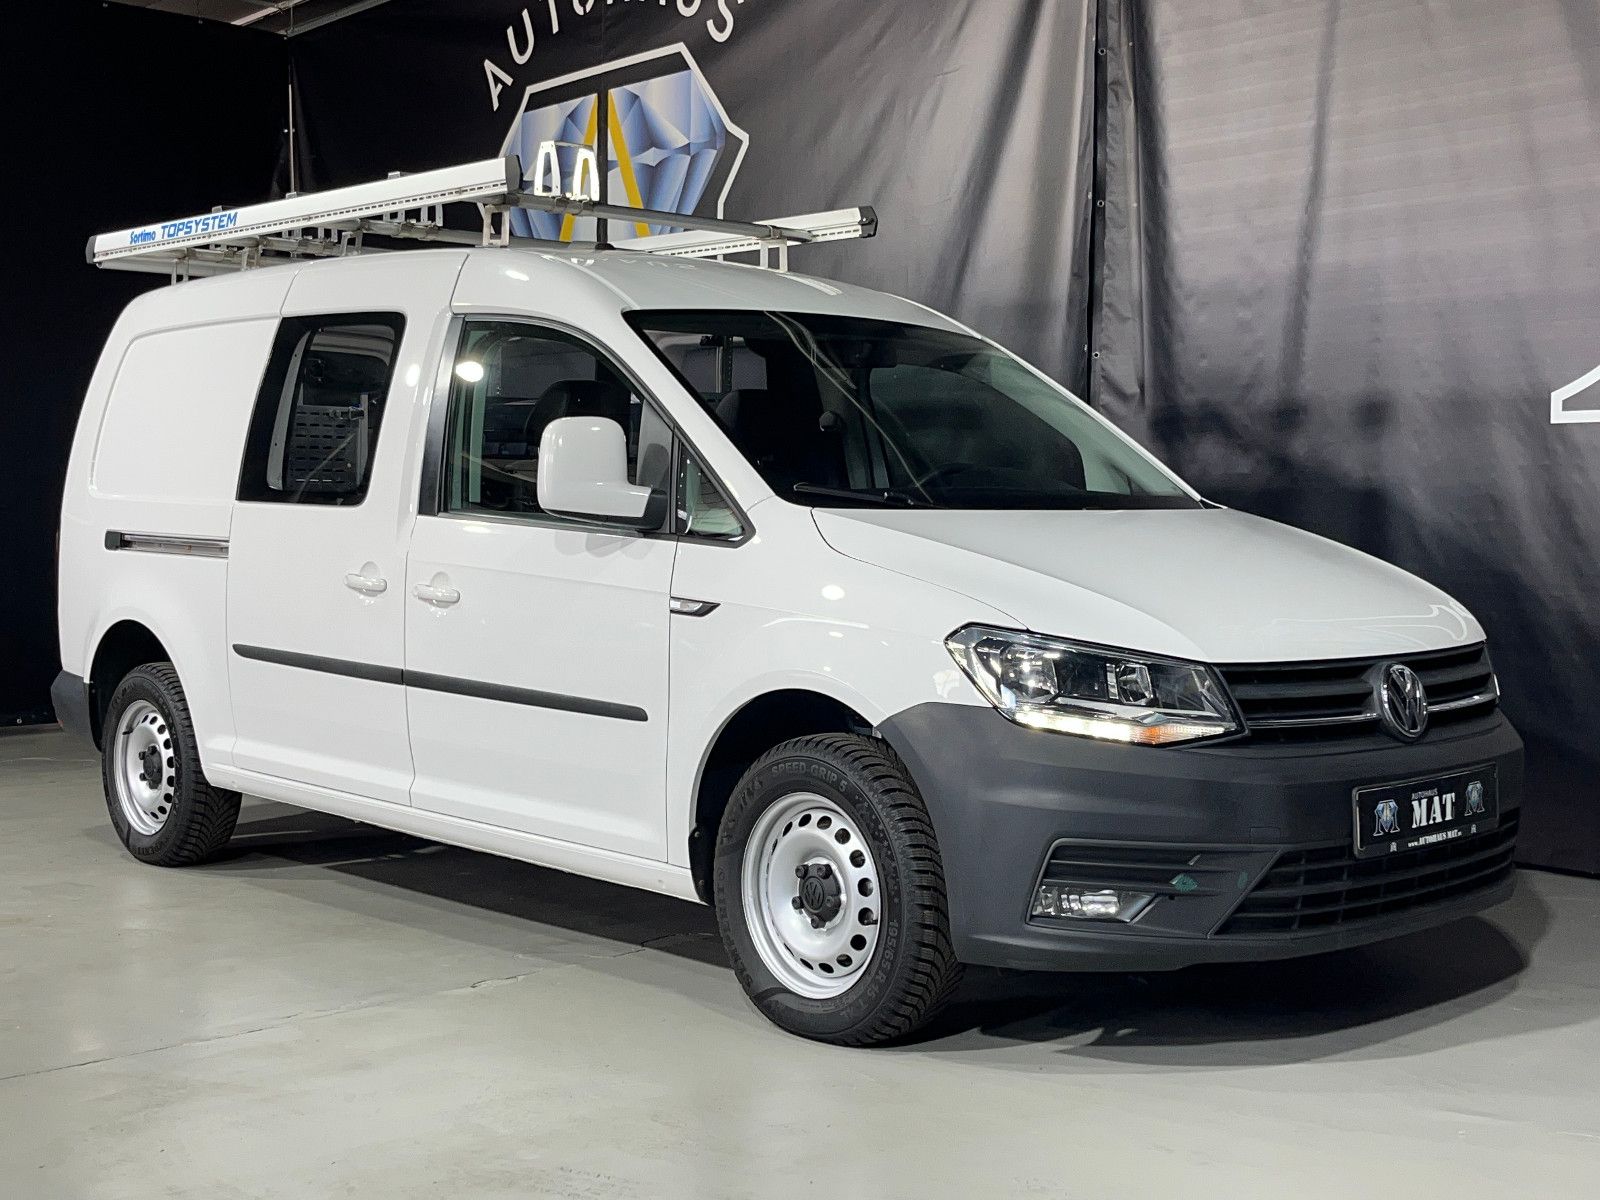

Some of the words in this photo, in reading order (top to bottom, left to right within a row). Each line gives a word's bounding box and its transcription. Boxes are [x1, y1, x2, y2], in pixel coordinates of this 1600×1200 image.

[130, 230, 156, 244] Sortimo
[161, 212, 238, 239] TOPSYSTEM
[1411, 792, 1455, 829] MAT
[881, 919, 899, 969] 195/65
